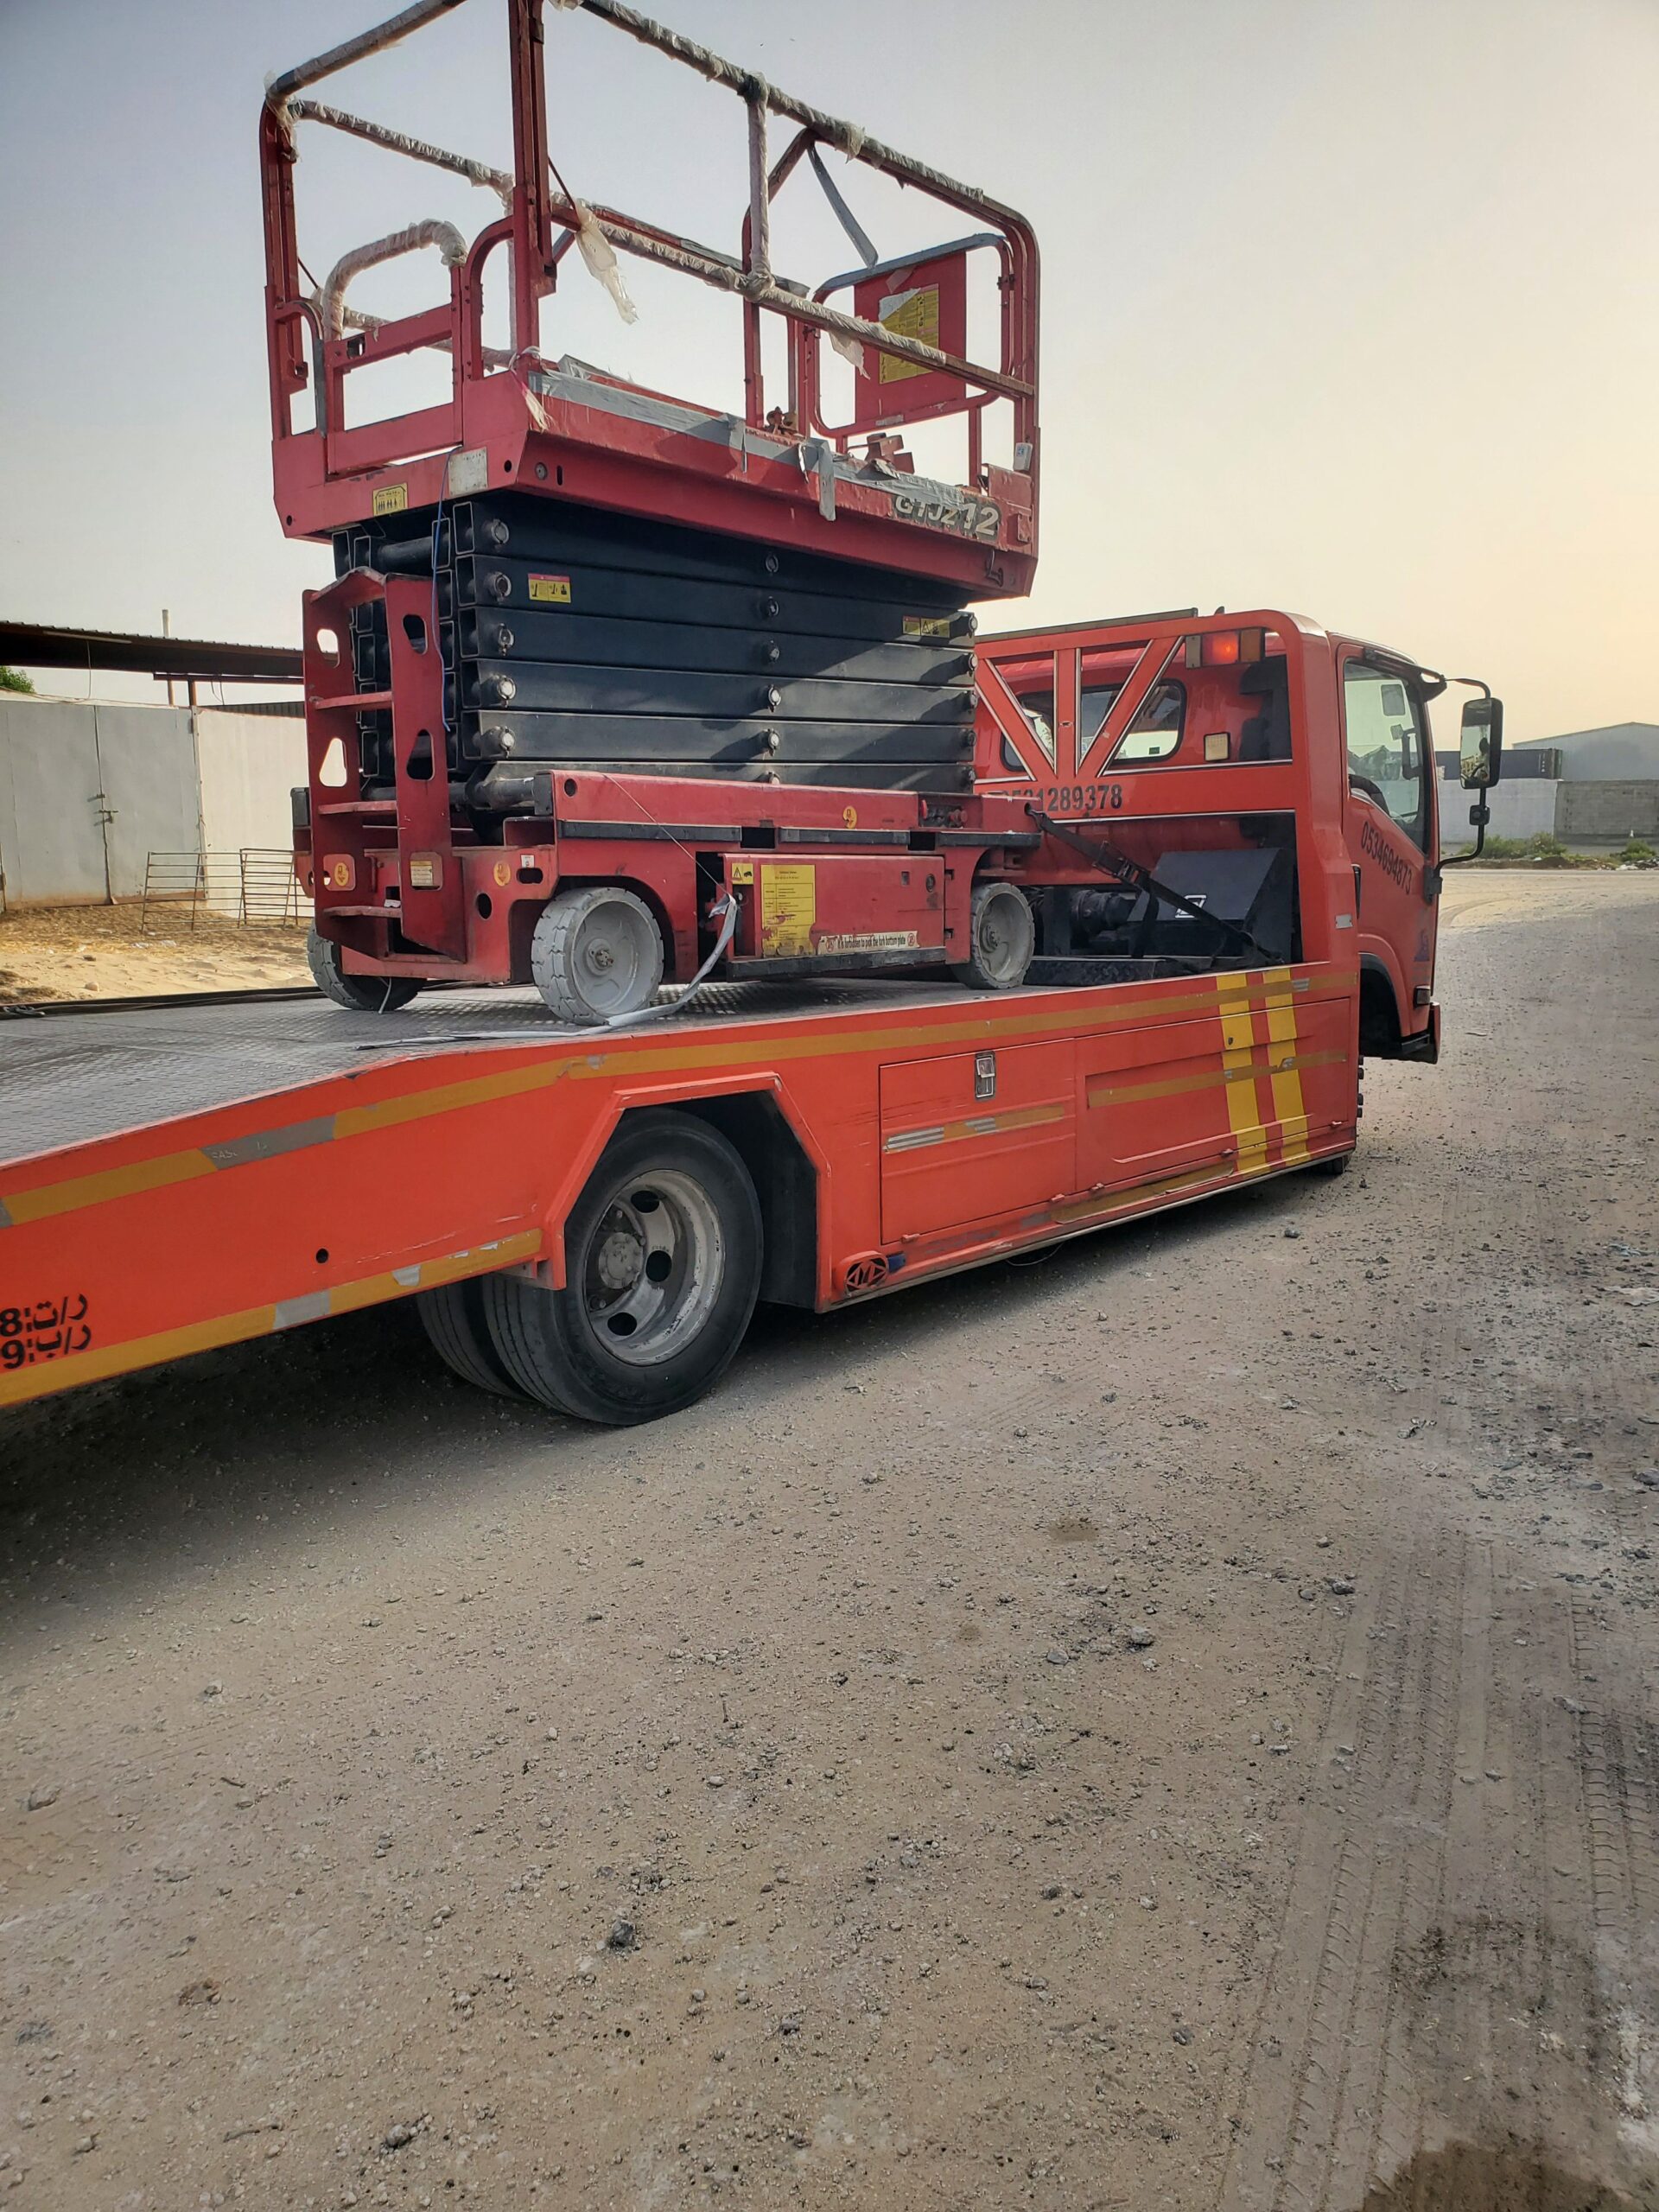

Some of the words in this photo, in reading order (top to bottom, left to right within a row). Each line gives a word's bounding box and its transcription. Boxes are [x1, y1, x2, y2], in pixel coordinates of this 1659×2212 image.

[895, 495, 1000, 536] GTJZ12
[1002, 785, 1122, 812] 289378
[1361, 821, 1413, 895] 0534694873
